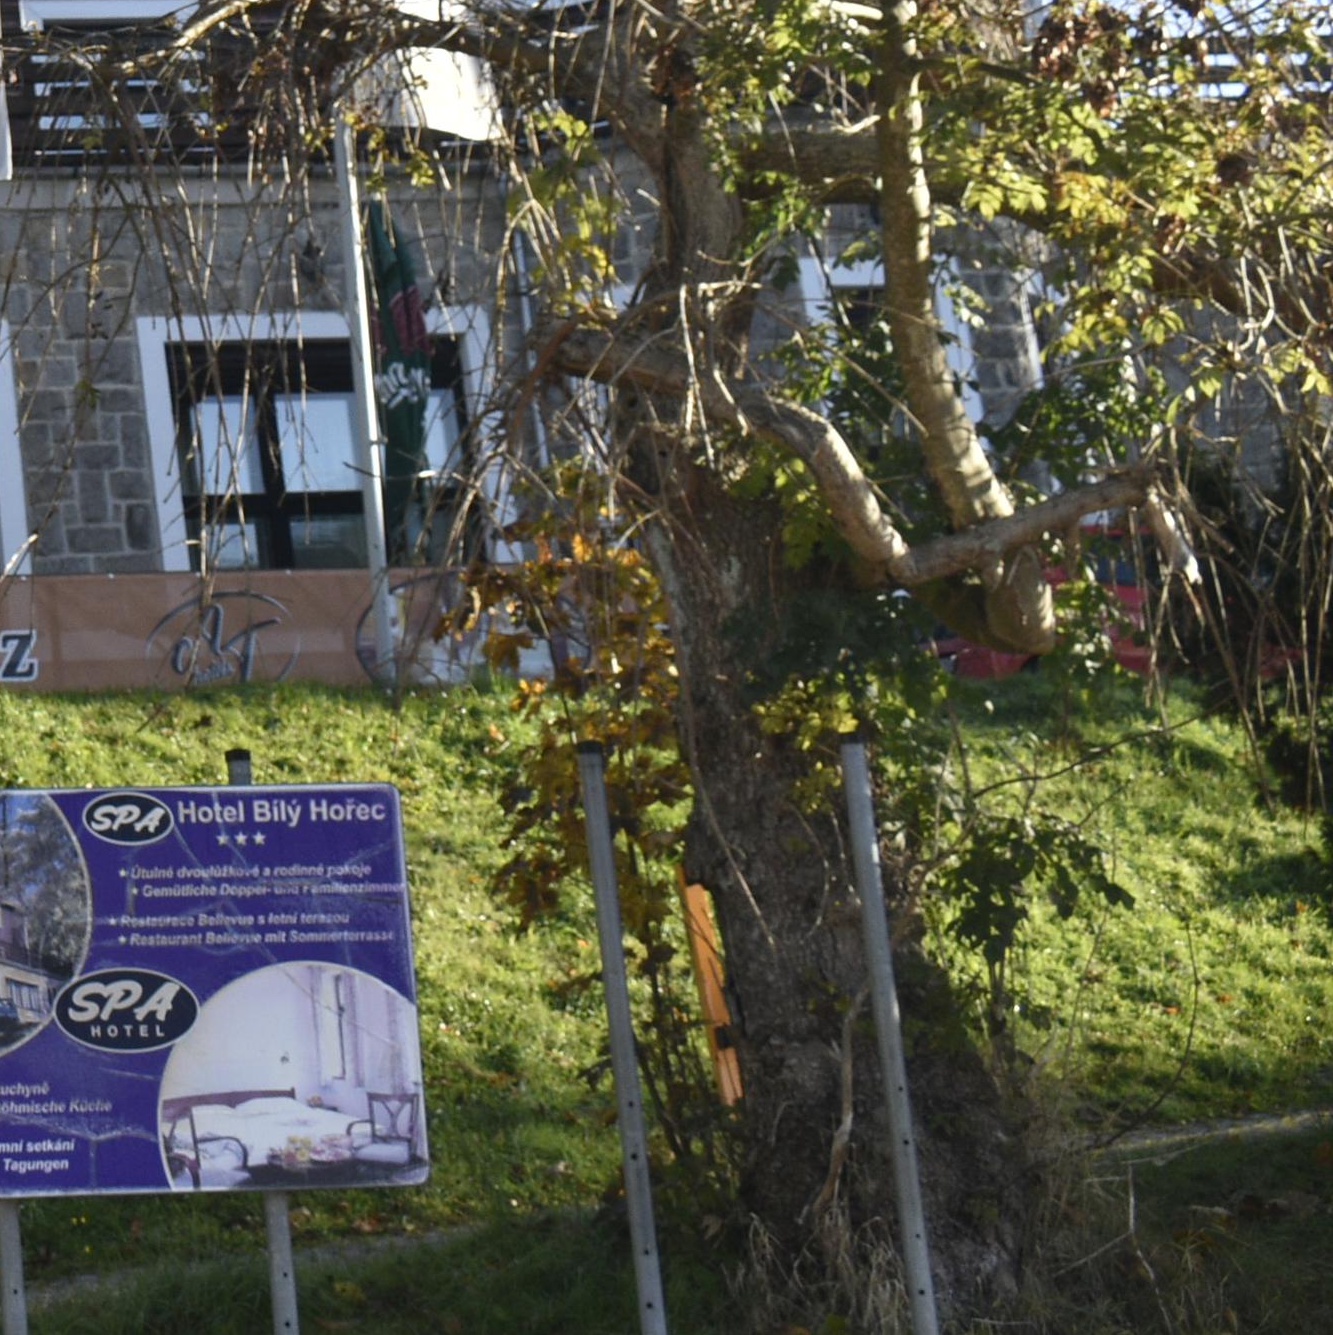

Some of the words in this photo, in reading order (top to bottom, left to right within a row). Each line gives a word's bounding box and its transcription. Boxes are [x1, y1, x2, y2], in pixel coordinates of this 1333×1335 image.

[91, 803, 165, 833] SPA
[177, 800, 245, 824] Hotel
[309, 798, 386, 822] Hořec
[130, 932, 202, 946] Restaurant
[264, 930, 286, 943] mit
[68, 979, 181, 1022] SPA
[90, 1025, 165, 1038] HOTEL
[26, 1138, 76, 1153] setkání
[3, 1157, 69, 1174] Tagungen
